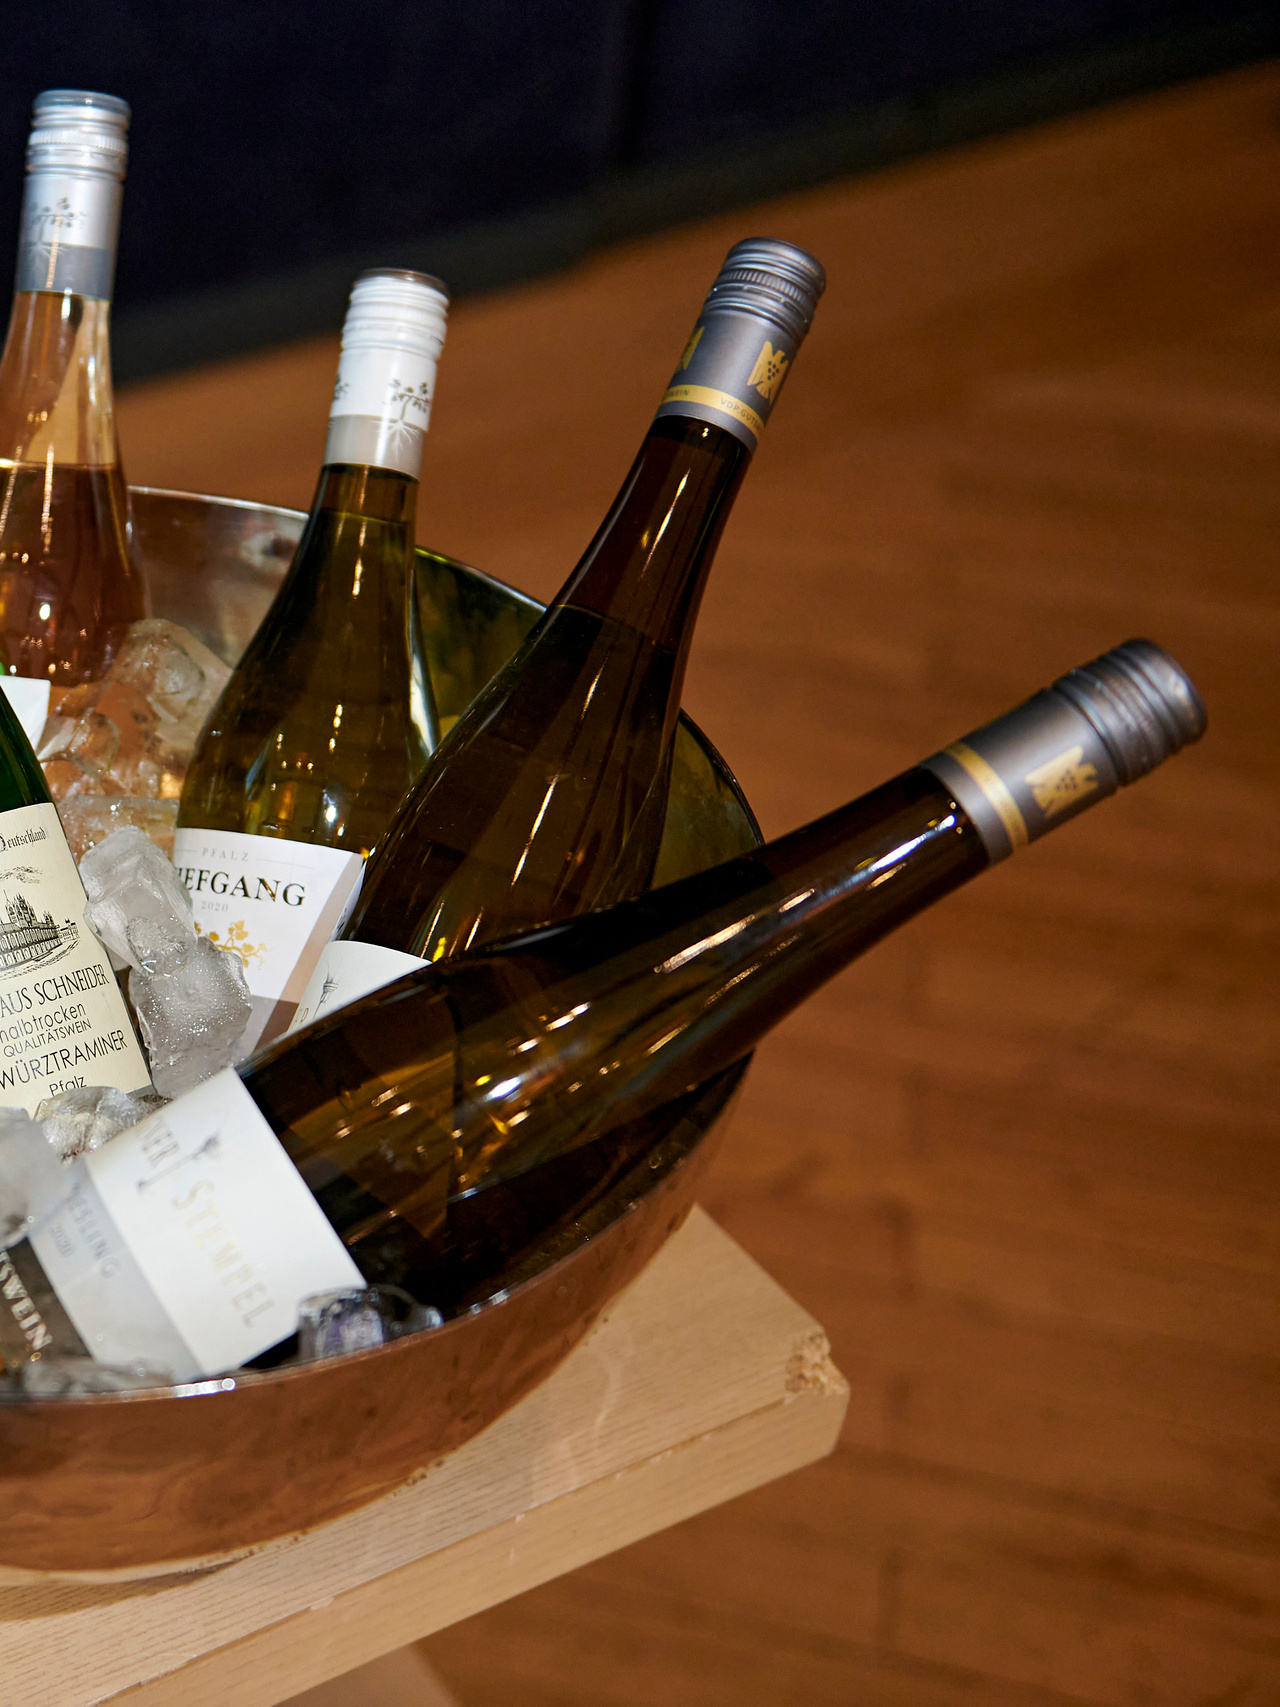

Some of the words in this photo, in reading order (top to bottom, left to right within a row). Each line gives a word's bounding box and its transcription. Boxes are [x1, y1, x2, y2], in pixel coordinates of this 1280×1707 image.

[202, 846, 250, 862] PFALZ
[33, 963, 110, 1006] SCHNEIDER
[3, 1018, 92, 1058] QUALITÄTSWEIN
[49, 1075, 88, 1097] Pfalz
[172, 1177, 275, 1328] STEMPEL
